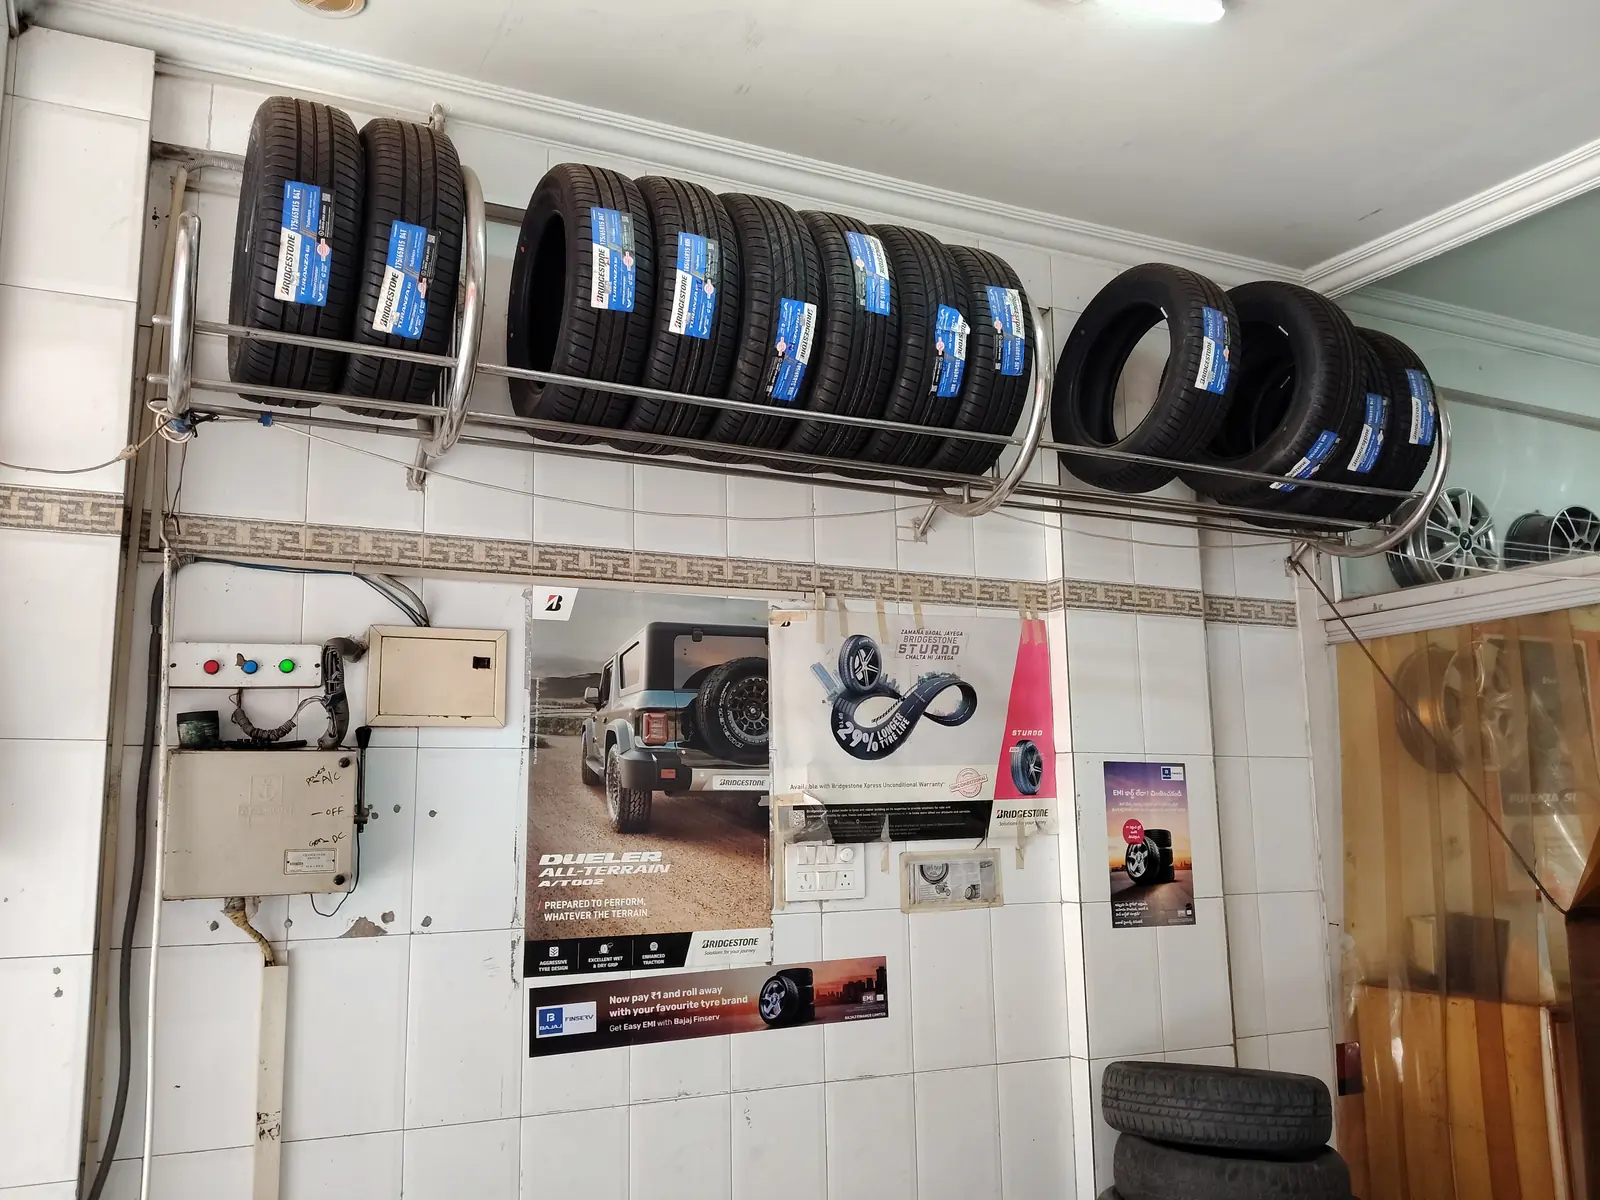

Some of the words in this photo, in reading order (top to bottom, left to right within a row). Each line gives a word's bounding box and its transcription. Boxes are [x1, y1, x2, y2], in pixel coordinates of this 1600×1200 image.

[280, 234, 296, 295] BRIDGESTONE
[300, 253, 309, 296] TURANZA
[596, 248, 606, 303] BRIDGESTONE
[379, 272, 400, 327] BRIDGESTONE
[398, 289, 411, 329] TURANZA
[674, 275, 688, 328] BRIDGESTONE
[800, 308, 814, 360] BRIDGESTONE
[1199, 341, 1212, 385] BRIDGESTONE
[903, 635, 958, 644] BRIDGESTONE
[898, 644, 960, 655] STURDO
[877, 712, 904, 740] LONGER
[880, 732, 898, 749] TYRE
[896, 717, 910, 735] LIFE
[837, 721, 879, 752] 29%
[325, 806, 345, 816] OFF
[996, 809, 1049, 819] BRIDGESTONE
[331, 832, 347, 844] DC
[538, 851, 662, 866] DUELER
[538, 864, 671, 877] ALL-TERRAIN
[537, 879, 605, 888] A/T002
[544, 900, 590, 910] PREPARED
[591, 899, 602, 908] TO
[544, 911, 591, 921] WHATEVER
[593, 911, 609, 919] THE
[612, 909, 648, 918] TERRAIN
[702, 938, 759, 948] BRIDGESTONE
[609, 995, 629, 1005] Now
[631, 994, 649, 1004] pay
[662, 989, 680, 999] and
[682, 987, 698, 997] roll
[699, 985, 723, 996] away
[609, 1007, 631, 1018] with
[632, 1005, 654, 1017] your
[656, 1001, 699, 1013] favourite
[701, 999, 720, 1010] tyre
[721, 995, 748, 1006] brand
[565, 1014, 594, 1022] FINSERV
[609, 1024, 622, 1032] Get
[623, 1022, 641, 1031] Easy
[642, 1021, 656, 1029] EMI
[657, 1019, 672, 1027] with
[674, 1017, 693, 1026] Bajaj
[693, 1013, 720, 1023] Finserv
